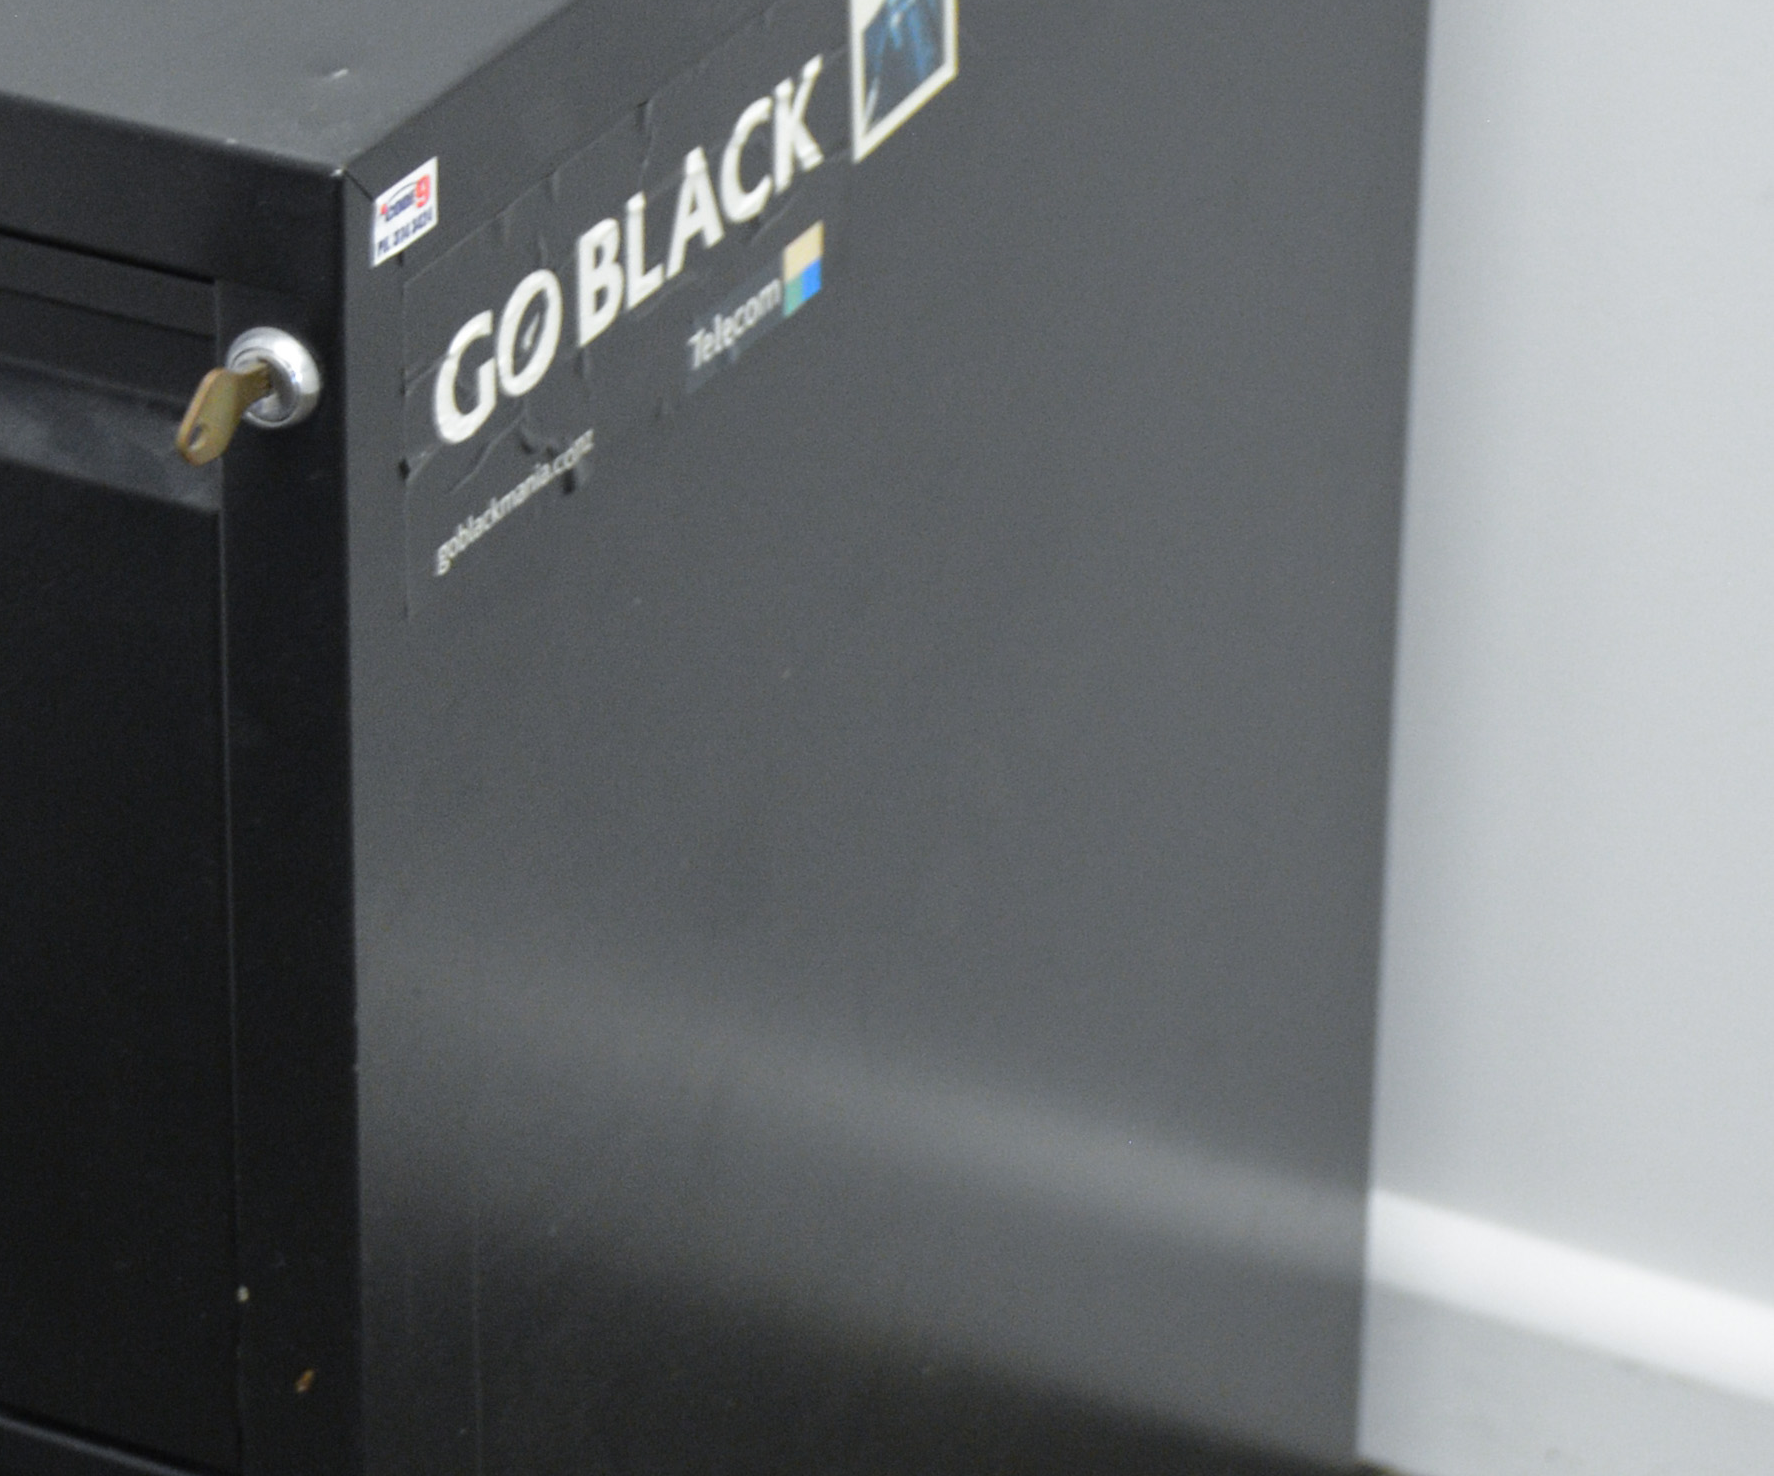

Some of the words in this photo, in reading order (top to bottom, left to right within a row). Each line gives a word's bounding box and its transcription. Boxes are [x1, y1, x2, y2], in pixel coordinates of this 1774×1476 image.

[433, 268, 563, 446] GO
[576, 54, 824, 349] BLACK
[687, 277, 782, 370] Telecom
